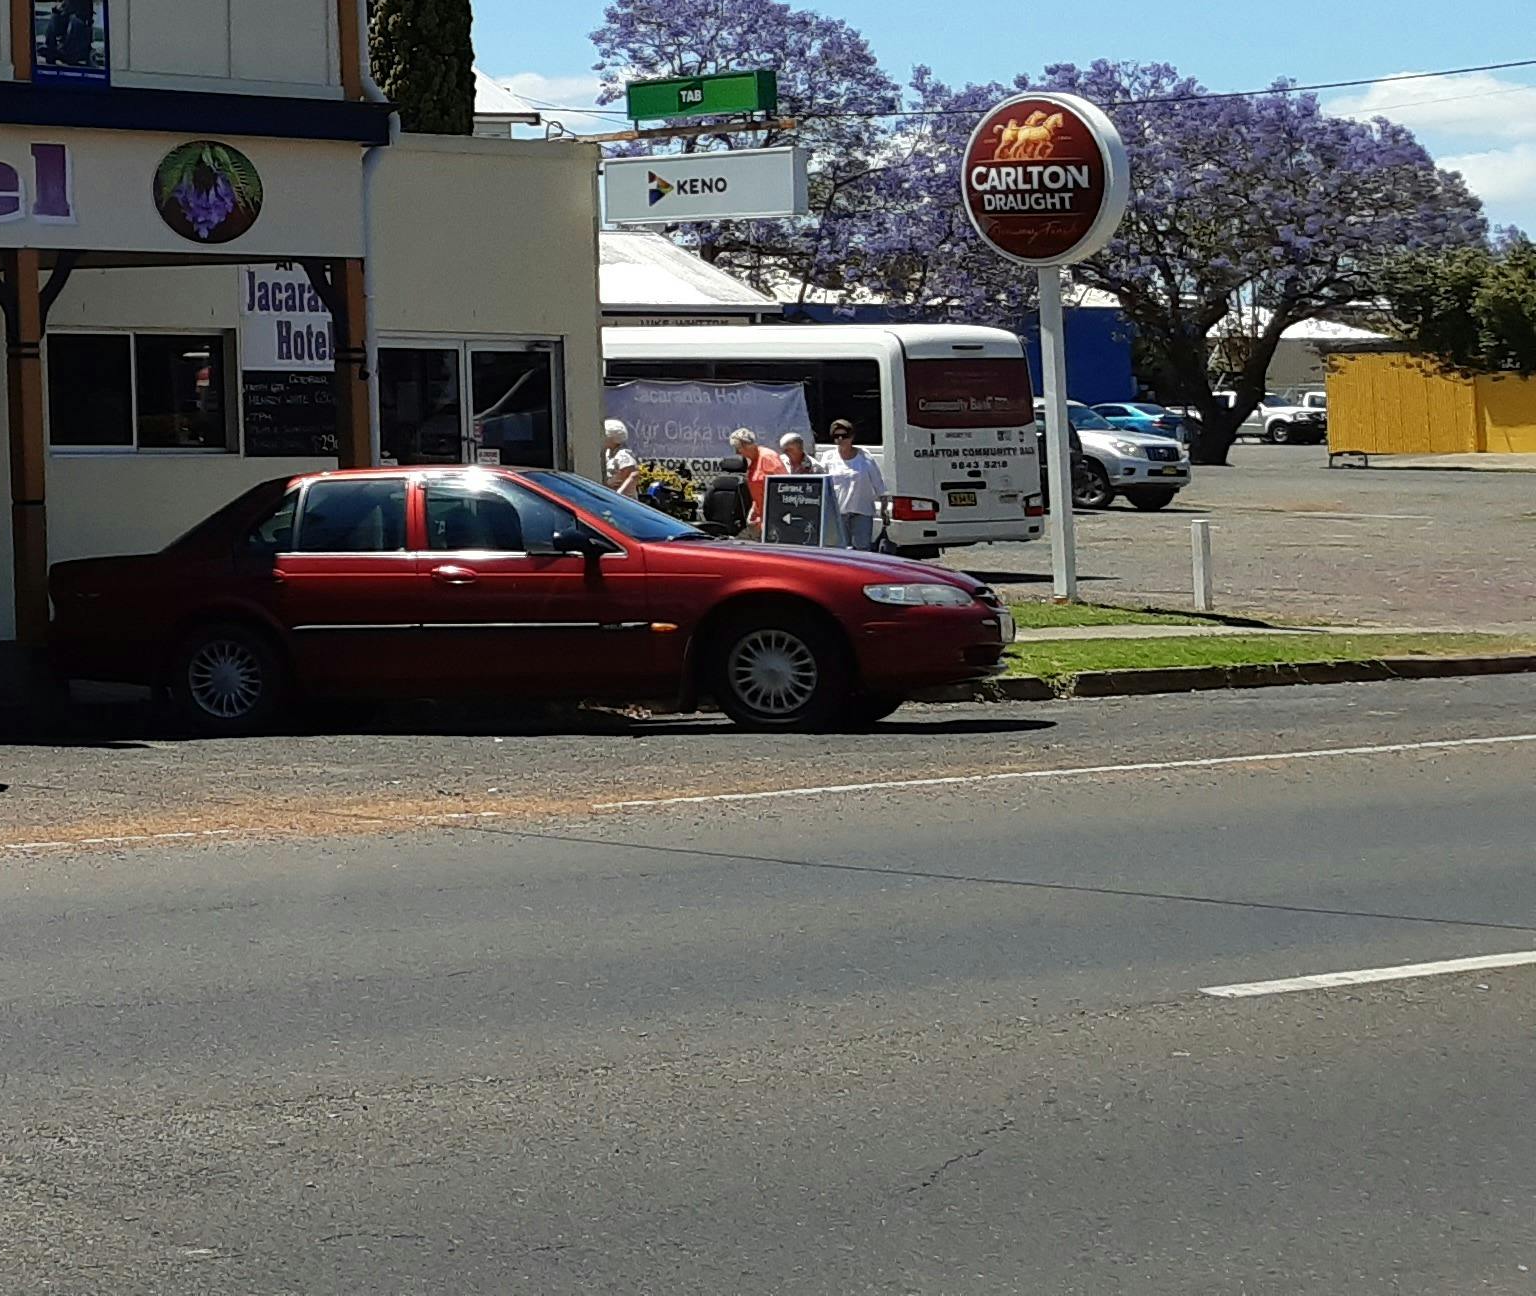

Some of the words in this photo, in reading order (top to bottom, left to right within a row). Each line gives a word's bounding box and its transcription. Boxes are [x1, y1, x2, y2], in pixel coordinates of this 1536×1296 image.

[680, 90, 702, 102] TAB
[676, 178, 727, 195] KENO
[971, 165, 1090, 191] CARLTON
[983, 192, 1073, 211] DRAUGHT
